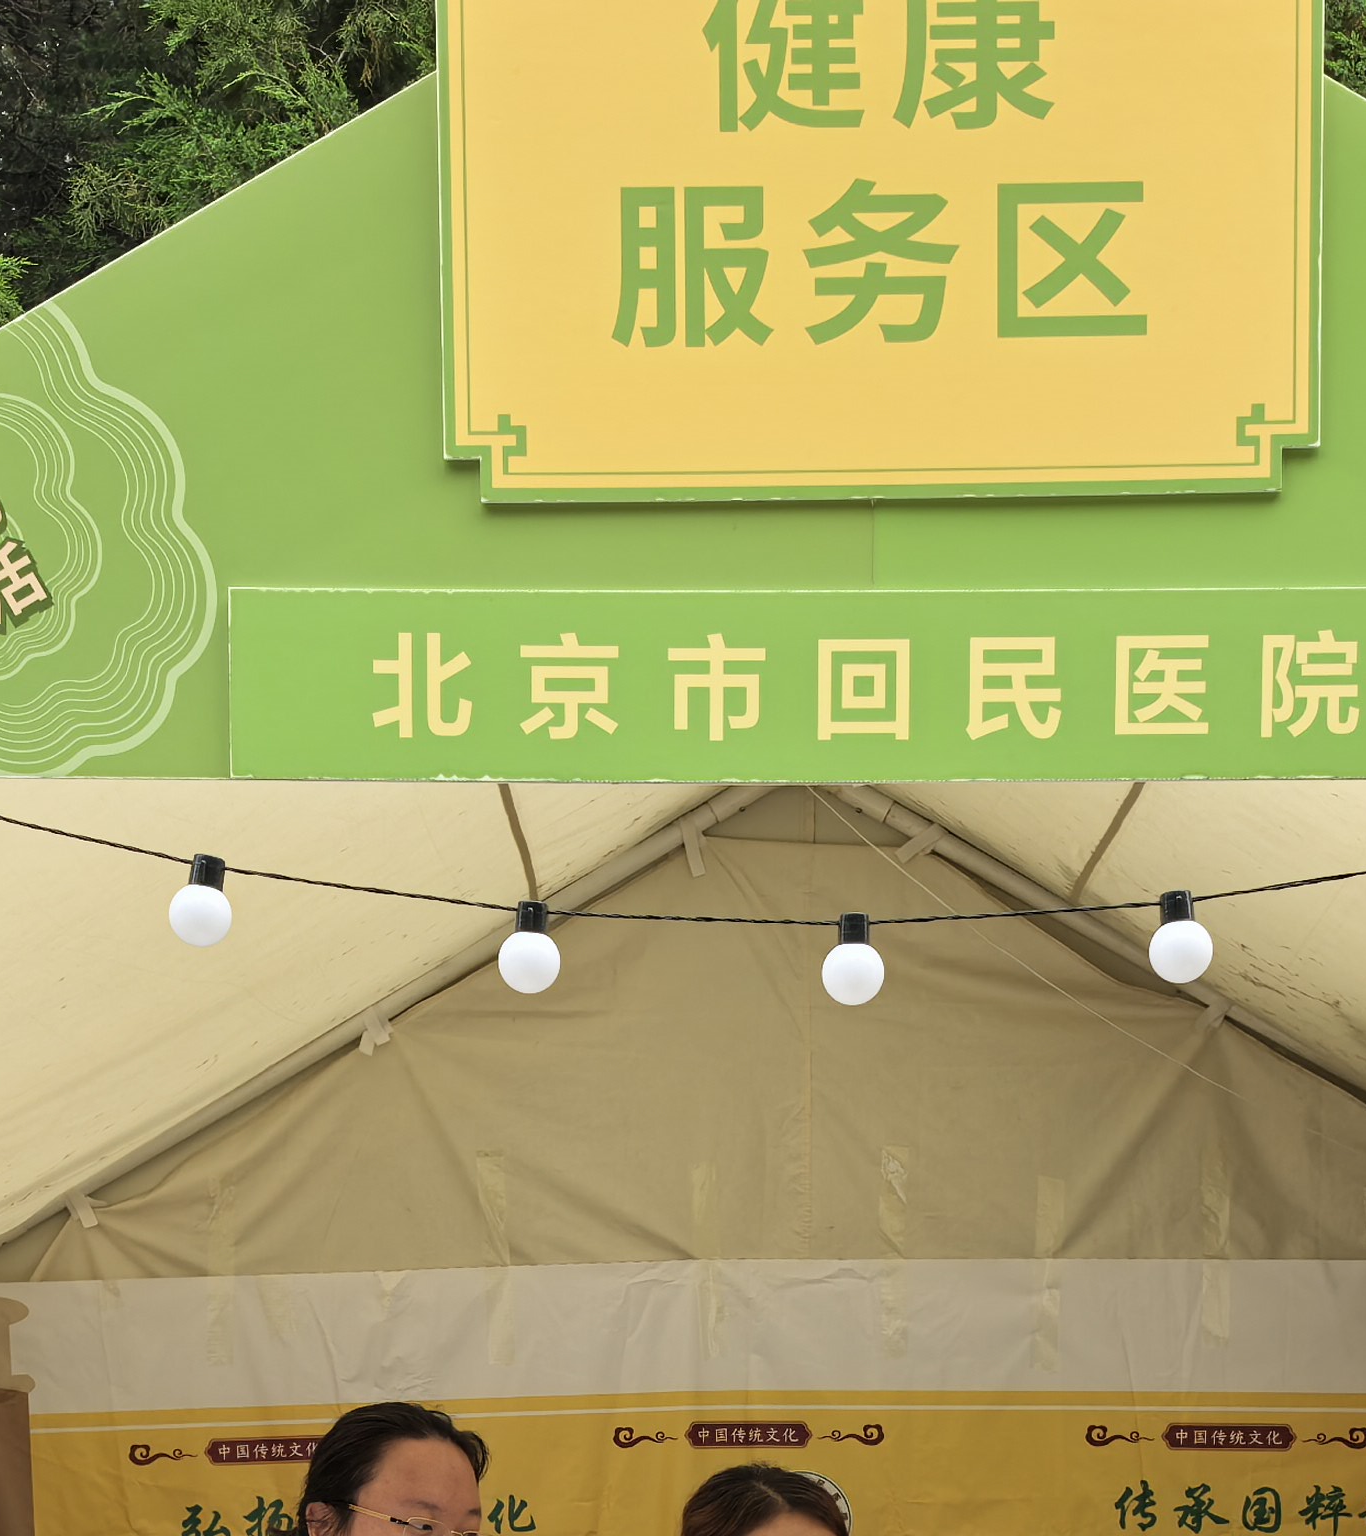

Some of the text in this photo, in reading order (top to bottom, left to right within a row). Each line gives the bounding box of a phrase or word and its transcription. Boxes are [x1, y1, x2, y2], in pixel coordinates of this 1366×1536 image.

[703, 0, 1059, 133] 健康
[610, 177, 1148, 349] 服务区
[370, 631, 1363, 743] 北京市回民医院
[697, 1426, 800, 1445] 中国传统文化
[1174, 1428, 1283, 1447] 中国传统文化
